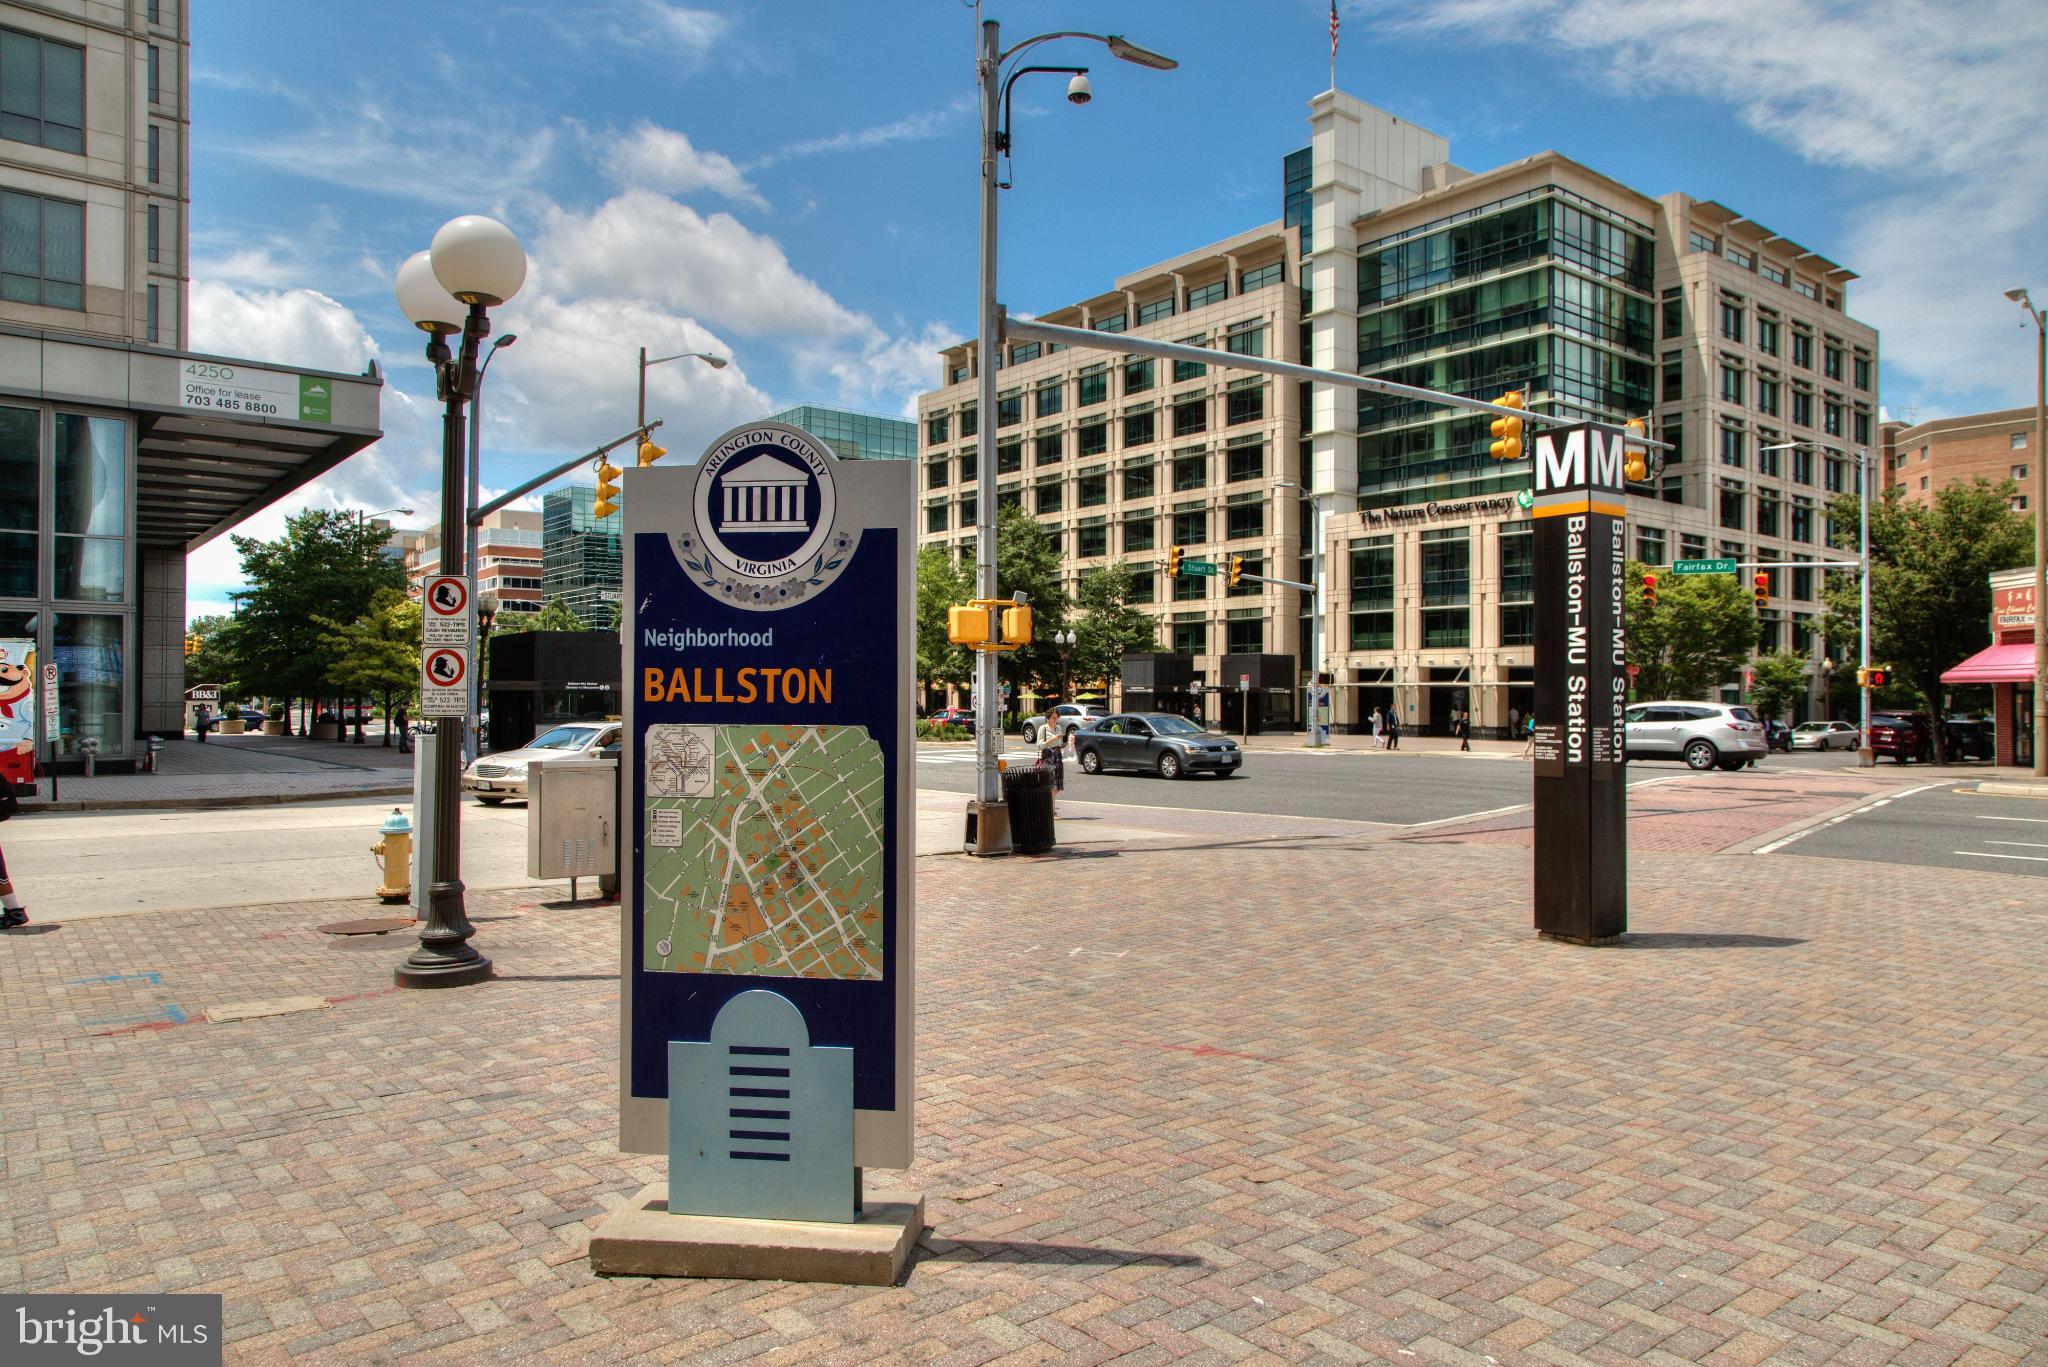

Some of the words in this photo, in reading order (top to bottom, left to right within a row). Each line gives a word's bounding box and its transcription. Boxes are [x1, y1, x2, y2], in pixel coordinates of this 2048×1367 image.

[186, 363, 234, 380] 4250
[186, 383, 216, 396] Office
[219, 387, 231, 398] for
[234, 389, 261, 401] lease
[186, 394, 211, 406] 703
[216, 398, 240, 410] 485
[245, 402, 277, 414] 8800
[705, 431, 773, 477] ARLINGTON
[780, 434, 828, 476] COUNTY
[1536, 429, 1585, 491] M
[1591, 429, 1623, 489] M
[1359, 510, 1381, 524] The
[1383, 508, 1425, 522] Nature
[1426, 496, 1514, 517] Conservancy
[736, 558, 797, 576] VIRGINIA
[1188, 564, 1206, 572] Stuart
[1677, 562, 1712, 571] Fairfax
[1716, 562, 1732, 570] Dr.
[1567, 515, 1587, 665] Ballston-MU
[1612, 518, 1625, 666] Ballston-MU
[644, 628, 773, 651] Neighborhood
[192, 690, 217, 699] BB&T
[644, 667, 832, 704] BALLSTON
[1567, 675, 1587, 764] Station
[1612, 676, 1625, 763] Station
